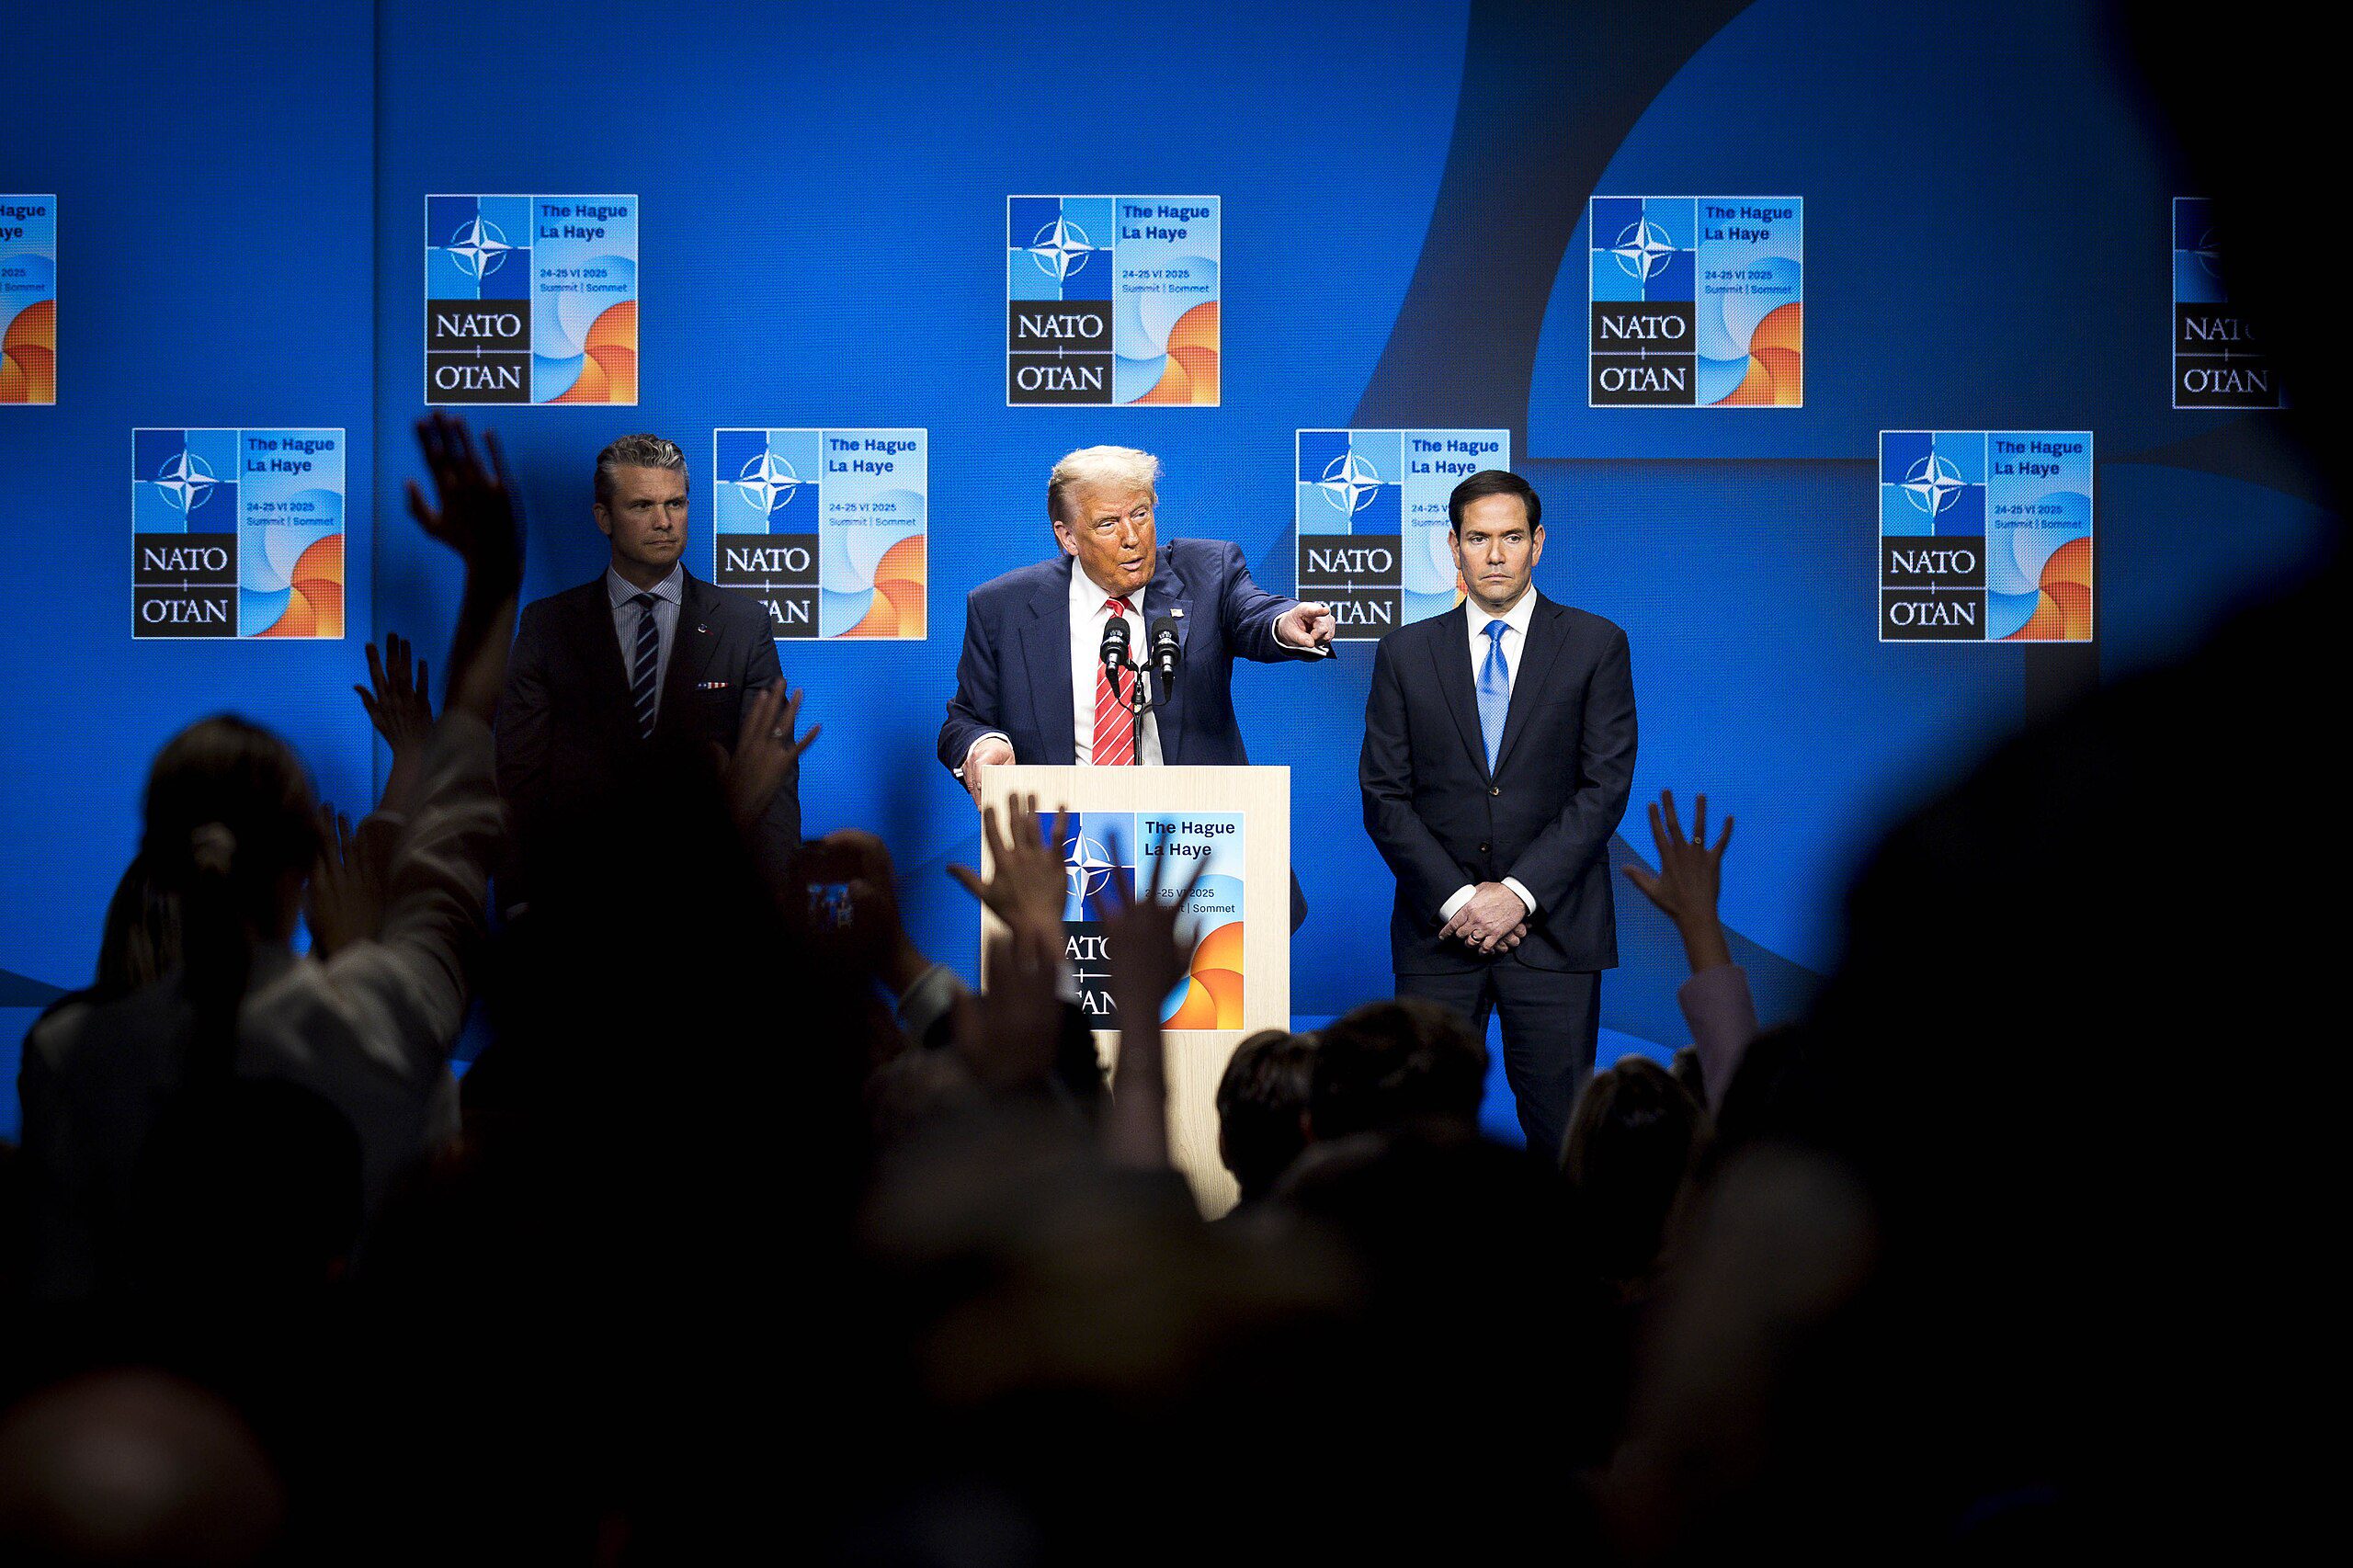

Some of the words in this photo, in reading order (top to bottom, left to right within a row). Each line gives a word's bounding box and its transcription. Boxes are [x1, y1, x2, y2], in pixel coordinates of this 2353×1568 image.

[542, 206, 570, 217] The
[575, 206, 628, 222] Hague
[1125, 206, 1153, 218] The
[1158, 206, 1211, 222] Hague
[1707, 207, 1735, 219] The
[1741, 207, 1792, 223] Hague
[540, 226, 559, 238] La
[563, 226, 605, 242] Haye
[1122, 226, 1142, 239] La
[1146, 226, 1187, 243] Haye
[1705, 227, 1723, 240] La
[1728, 227, 1769, 244] Haye
[540, 268, 568, 278] 24-25
[570, 268, 580, 278] VI
[583, 268, 608, 278] 2025
[1122, 269, 1151, 278] 24-25
[1153, 269, 1163, 278] VI
[1165, 269, 1190, 278] 2025
[1705, 270, 1733, 279] 24-25
[1735, 270, 1745, 279] VI
[1747, 270, 1772, 279] 2025
[540, 283, 577, 292] Summit
[586, 283, 627, 292] Sommet
[1122, 284, 1160, 292] Summit
[1169, 284, 1210, 292] Sommet
[1705, 285, 1743, 294] Summit
[1751, 285, 1792, 294] Sommet
[436, 314, 522, 338] NATO
[1018, 314, 1105, 338] NATO
[1600, 315, 1687, 339] NATO
[435, 366, 522, 390] OTAN
[1017, 367, 1105, 391] OTAN
[1599, 368, 1688, 392] OTAN
[2184, 369, 2269, 392] OTAN
[250, 439, 278, 450] The
[283, 439, 335, 455] Hague
[832, 439, 859, 450] The
[865, 439, 917, 455] Hague
[1414, 440, 1441, 451] The
[1447, 440, 1498, 456] Hague
[1996, 441, 2025, 453] The
[2030, 441, 2082, 458] Hague
[247, 460, 267, 472] La
[271, 460, 312, 475] Haye
[829, 460, 848, 472] La
[853, 460, 893, 476] Haye
[1411, 460, 1430, 472] La
[1434, 460, 1475, 477] Haye
[1995, 461, 2013, 474] La
[2018, 461, 2059, 478] Haye
[247, 502, 275, 511] 24-25
[278, 502, 288, 511] VI
[290, 502, 315, 511] 2025
[829, 502, 857, 511] 24-25
[859, 502, 870, 511] VI
[872, 502, 897, 511] 2025
[1411, 503, 1438, 512] 24-25
[1995, 505, 2022, 514] 24-25
[2025, 505, 2034, 514] VI
[2037, 505, 2062, 514] 2025
[247, 517, 285, 526] Summit
[294, 517, 335, 526] Sommet
[829, 517, 867, 526] Summit
[876, 517, 916, 526] Sommet
[1995, 519, 2032, 528] Summit
[2040, 519, 2082, 528] Sommet
[143, 548, 230, 572] NATO
[725, 548, 812, 572] NATO
[1307, 549, 1393, 573] NATO
[1890, 550, 1976, 574] NATO
[142, 599, 230, 623] OTAN
[758, 600, 811, 623] AN
[1329, 601, 1392, 625] TAN
[1889, 602, 1977, 626] OTAN
[1145, 822, 1176, 834] The
[1182, 822, 1235, 838] Hague
[1145, 844, 1164, 856] La
[1169, 844, 1211, 860] Haye
[1145, 888, 1175, 897] 2-25
[1189, 888, 1215, 897] 2025
[1193, 904, 1235, 913] Sommet
[1074, 990, 1119, 1015] AN
